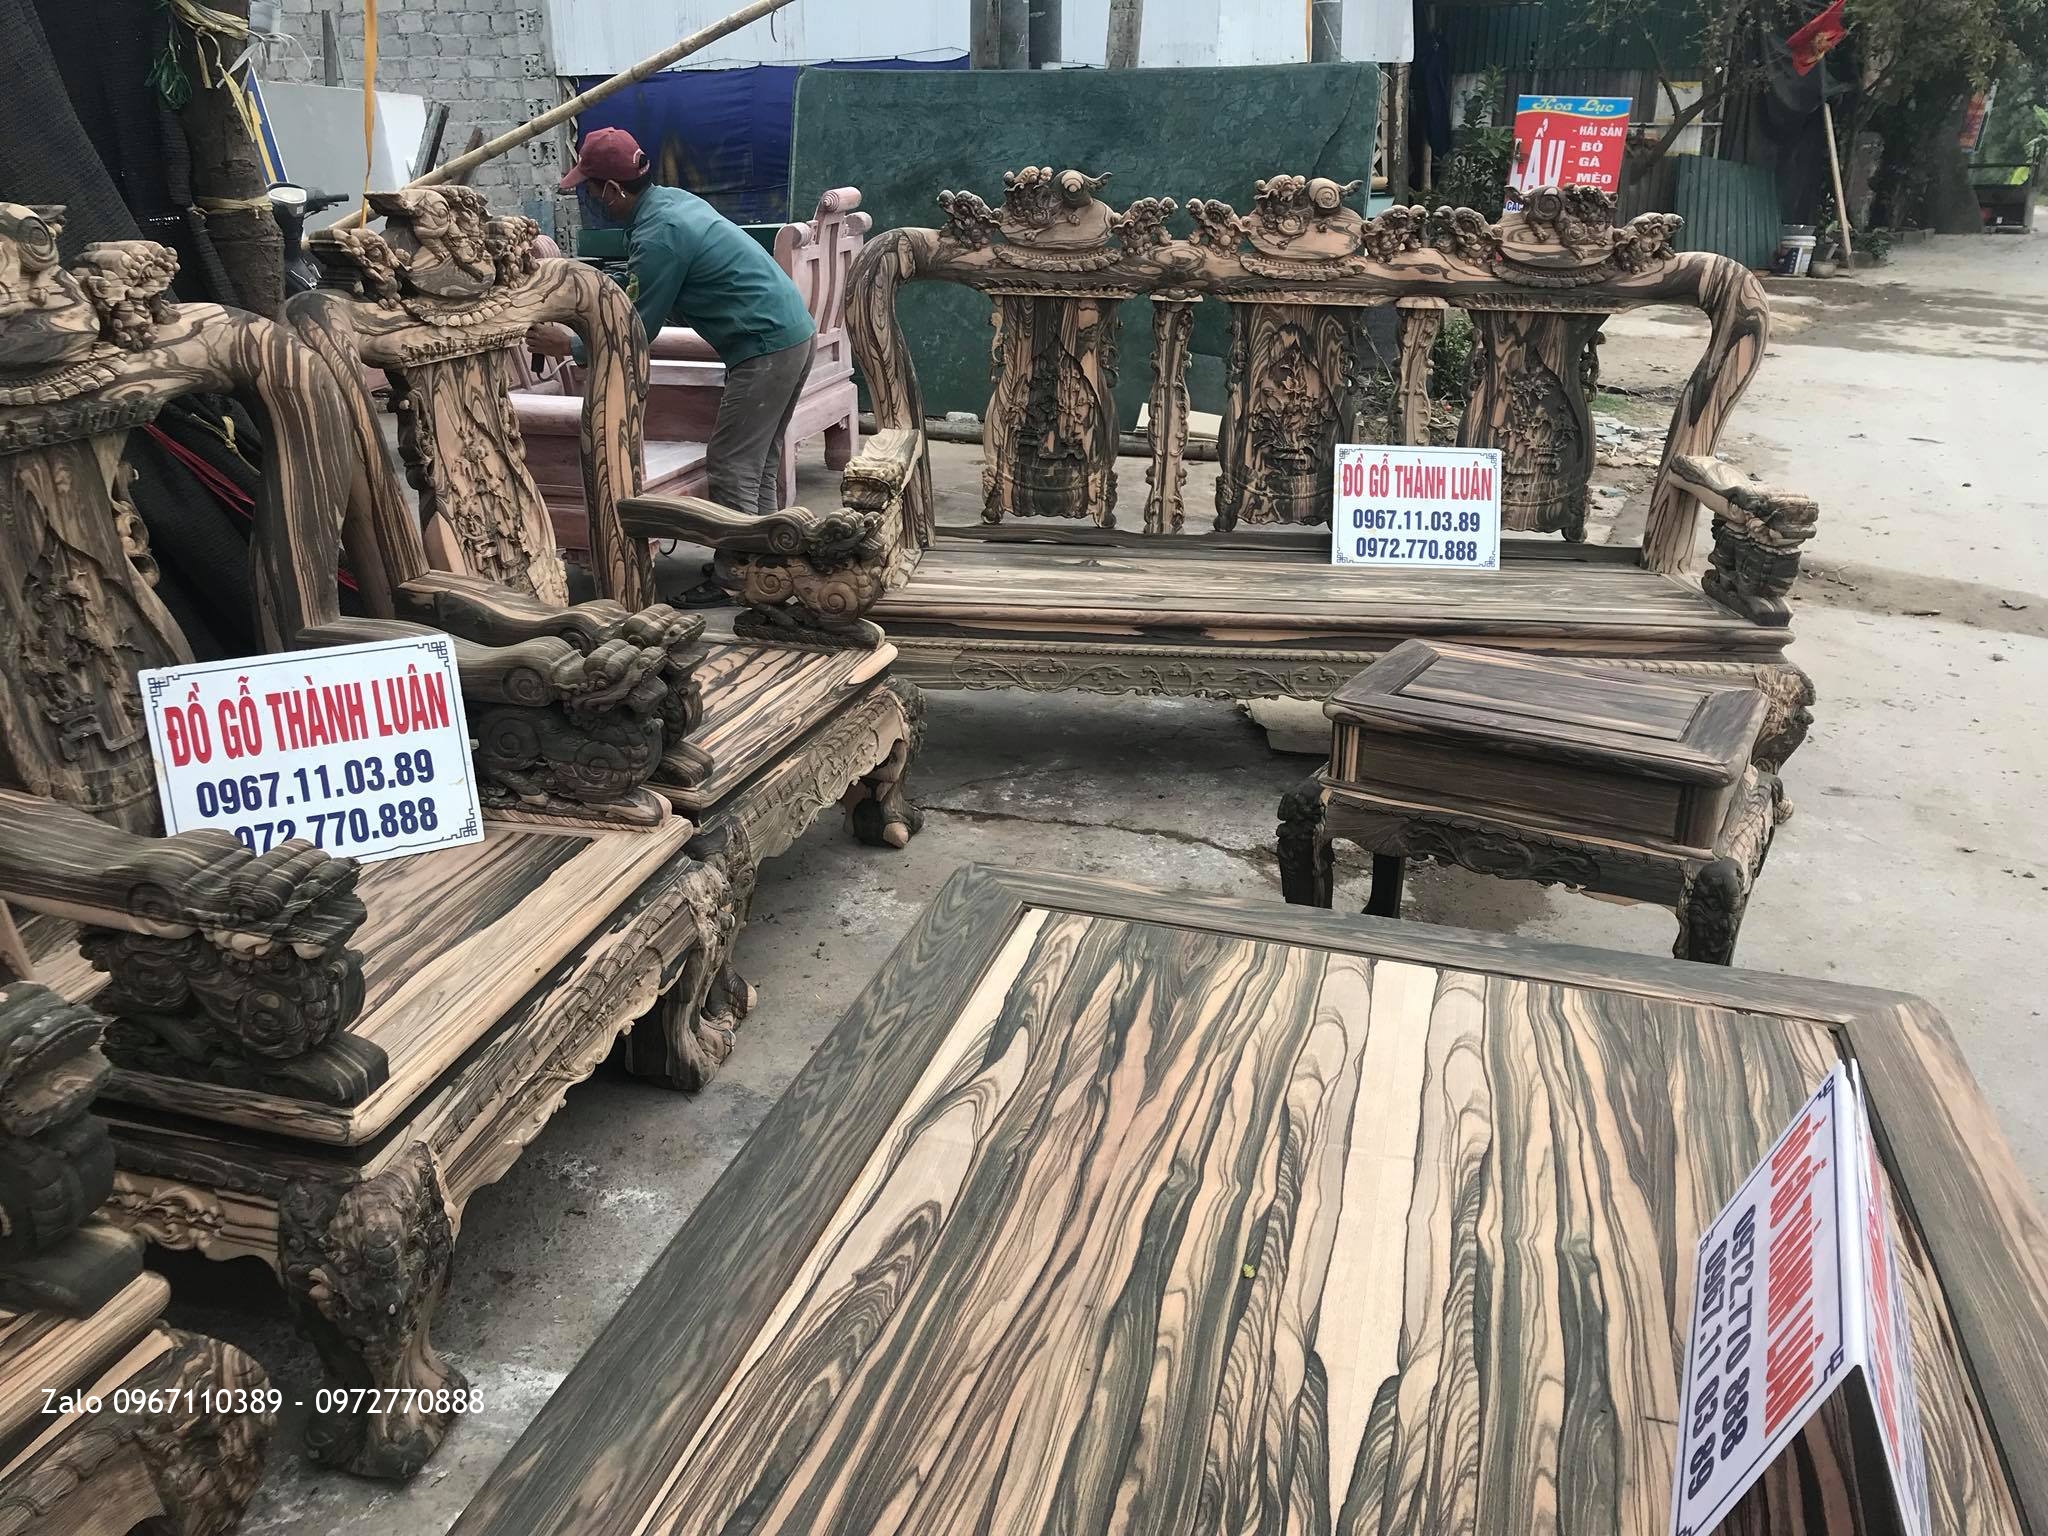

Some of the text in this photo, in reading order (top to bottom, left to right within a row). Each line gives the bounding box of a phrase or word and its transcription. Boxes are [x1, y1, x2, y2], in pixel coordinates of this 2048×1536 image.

[1343, 453, 1493, 501] ĐỒ GỖ THÀNH LUÂN
[1353, 508, 1480, 532] 0967.11.03.89
[1356, 537, 1477, 561] 0972.770.888
[164, 663, 451, 767] ĐỒ GỖ THÀNH LUÂN
[196, 749, 435, 818] 0967.11.03.89
[1768, 1192, 1822, 1338] THÀNH
